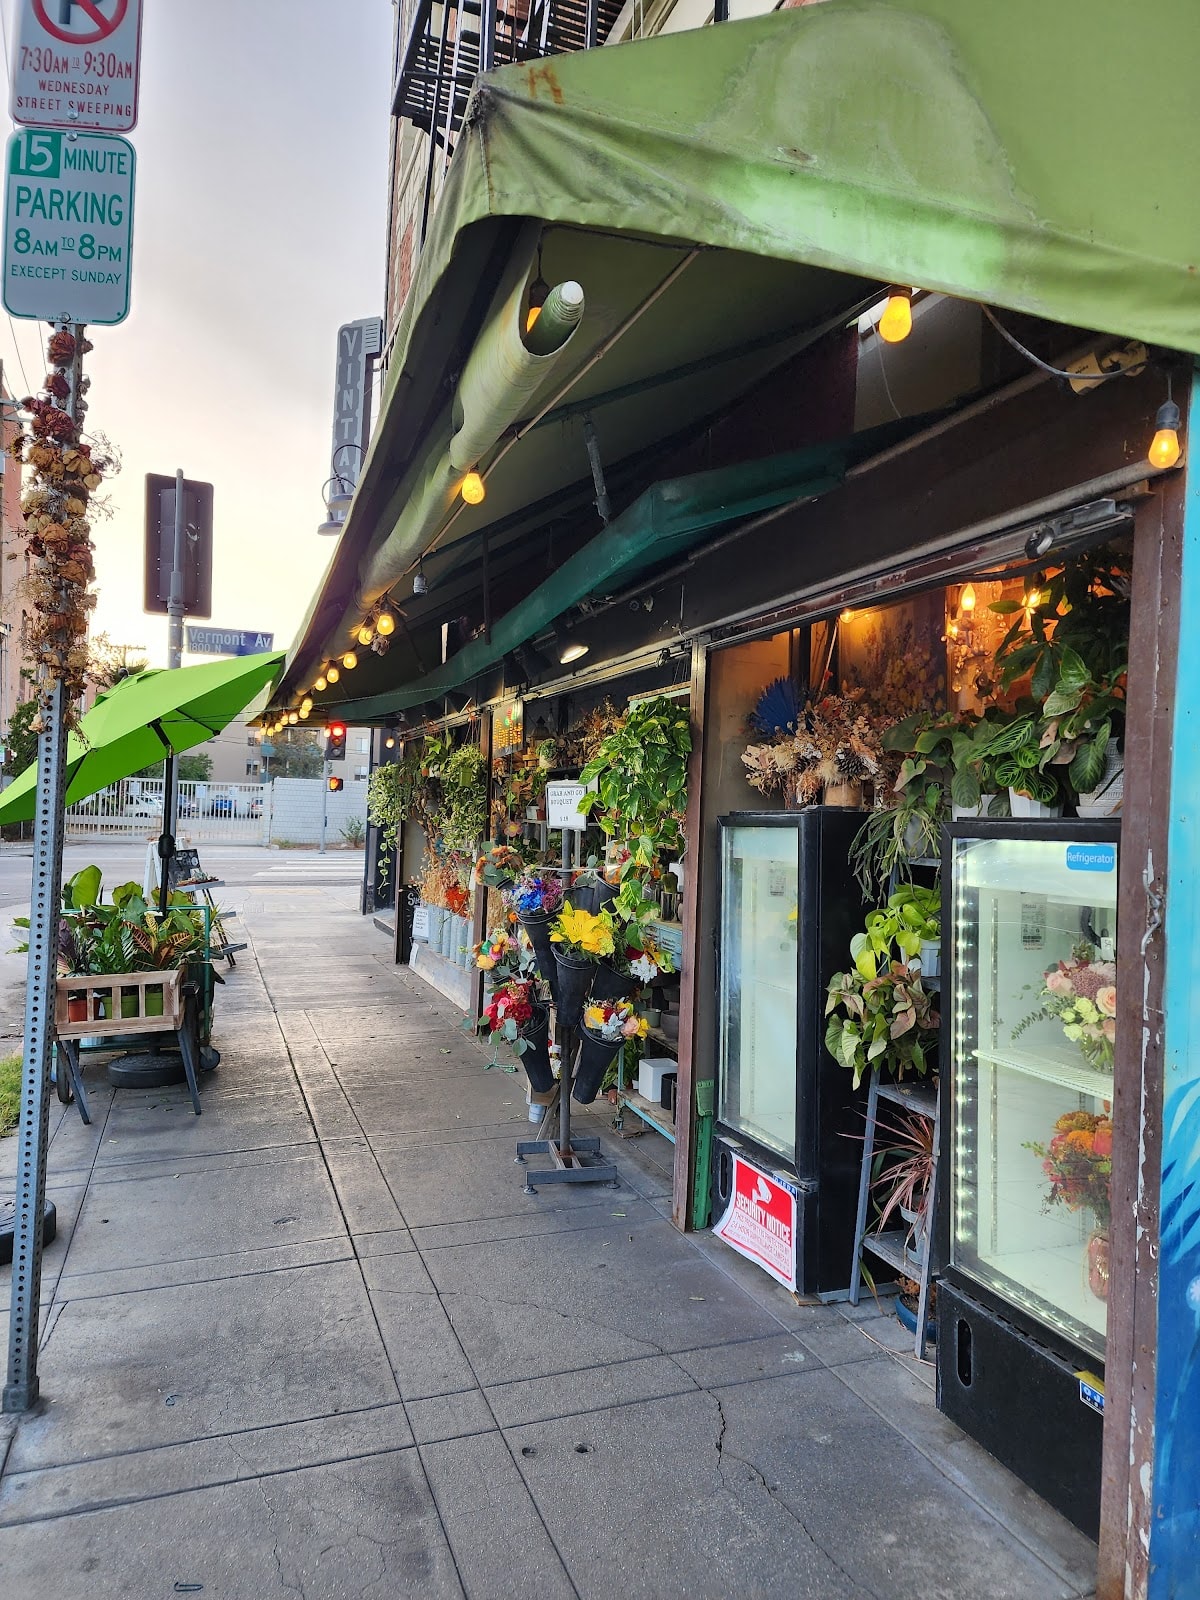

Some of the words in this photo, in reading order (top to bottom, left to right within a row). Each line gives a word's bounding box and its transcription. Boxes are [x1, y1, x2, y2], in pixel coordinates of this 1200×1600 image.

[21, 46, 69, 73] 7:30AM
[84, 50, 132, 79] 9:30AM
[39, 80, 110, 96] WEDNESDAY
[17, 95, 61, 111] STREET
[68, 100, 131, 117] SWEEPING
[18, 134, 53, 172] 15
[64, 147, 127, 175] MINUTE
[15, 185, 123, 226] PARKING
[13, 227, 58, 257] 8AM
[61, 236, 75, 251] TO
[78, 233, 122, 262] 8PM
[11, 264, 67, 280] EXECEPT
[71, 269, 122, 285] SUNDAY
[189, 627, 246, 647] Vermont
[254, 633, 271, 648] Av
[214, 644, 222, 653] N
[1067, 852, 1114, 865] Refrigerator
[736, 1191, 766, 1225] SECURITY
[766, 1211, 791, 1245] NOTICE
